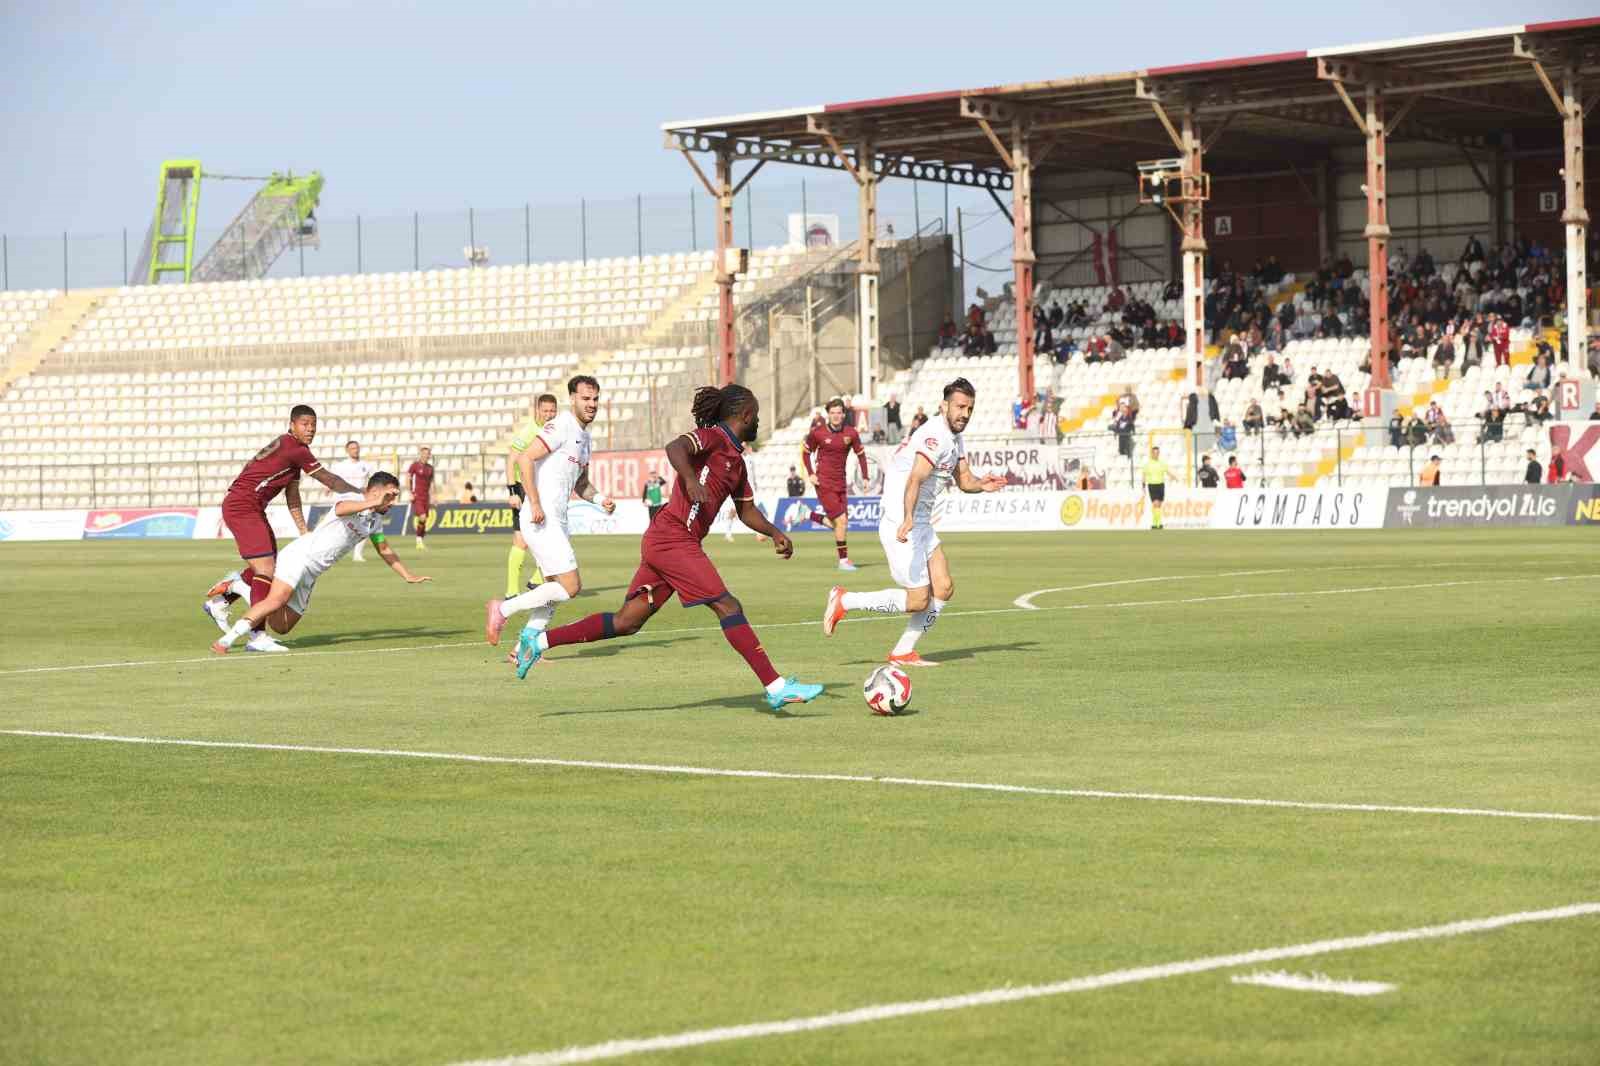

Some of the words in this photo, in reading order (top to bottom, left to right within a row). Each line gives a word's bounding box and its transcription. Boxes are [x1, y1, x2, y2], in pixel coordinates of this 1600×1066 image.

[967, 449, 1039, 467] MASPOR
[945, 498, 1047, 515] EVRENSAN
[1086, 497, 1146, 525] Happy
[1162, 498, 1214, 518] enter
[1236, 492, 1363, 526] COMPASS
[1427, 493, 1518, 521] trendyol
